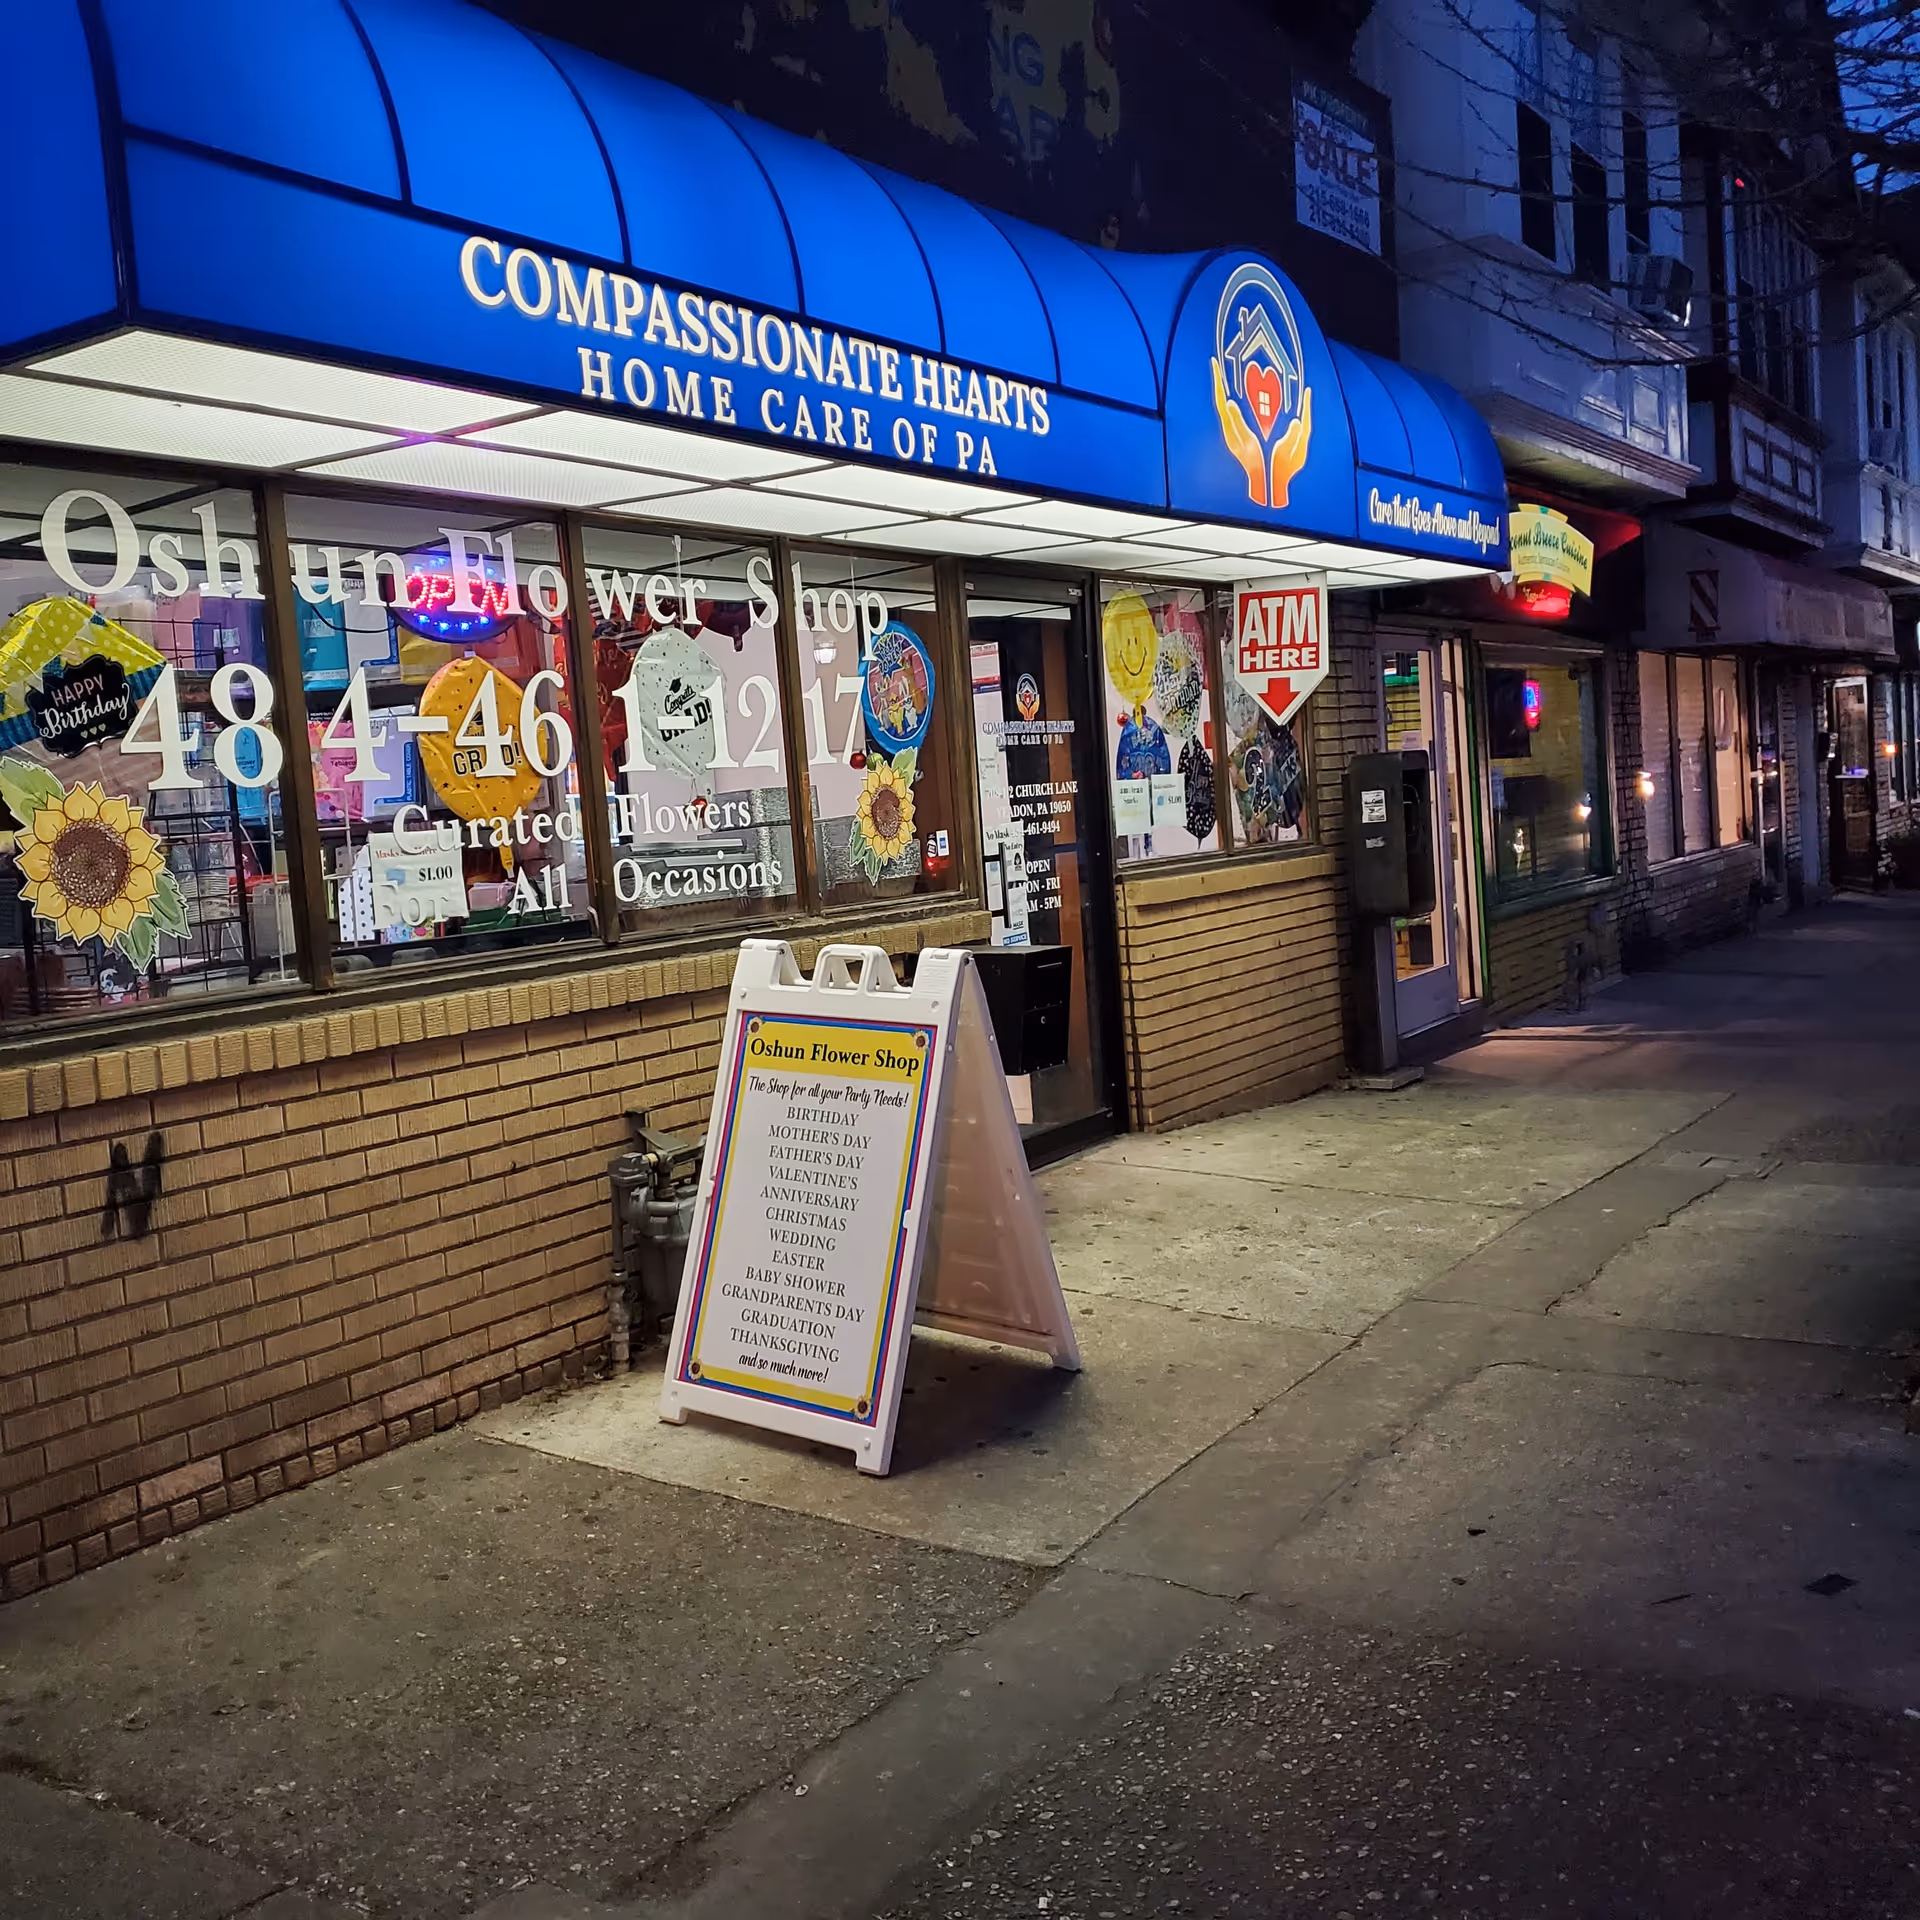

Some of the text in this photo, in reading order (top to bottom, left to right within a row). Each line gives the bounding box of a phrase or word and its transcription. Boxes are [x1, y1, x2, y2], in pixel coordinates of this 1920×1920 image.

[1302, 117, 1378, 198] SALE
[460, 236, 1050, 435] COMPASSIONATE HEARTS
[577, 347, 998, 477] HOME CARE OF PA
[1369, 487, 1500, 554] Care that Goes Above and Beyond
[1533, 521, 1560, 550] Breeze
[1560, 531, 1588, 570] Cuisine
[40, 489, 888, 661] Oshun Flower Shop
[1240, 593, 1318, 648] ATM
[1243, 647, 1317, 670] HERE
[51, 673, 104, 707] HAPPY
[38, 682, 130, 739] Birthday
[121, 662, 865, 791] 484-461-1217
[1020, 735, 1041, 746] CARE
[453, 742, 522, 776] GRD!
[1015, 783, 1054, 798] CHURCH
[1054, 781, 1078, 795] LANE
[393, 794, 752, 853] Curated Flowers
[1037, 803, 1049, 816] PA
[1049, 800, 1072, 815] 19050
[419, 865, 453, 882] $1.00
[1026, 859, 1051, 874] OPEN
[373, 857, 783, 930] For All Occasions
[1045, 877, 1061, 893] FRI
[1026, 899, 1039, 913] AM
[1044, 895, 1062, 910] 5PM
[750, 1036, 920, 1077] Oshun Flower Shop
[749, 1075, 909, 1109] The Shop for all your Party Needs!
[786, 1106, 860, 1127] BIRTHDAY
[768, 1124, 872, 1150] MOTHER'S DAY
[769, 1144, 865, 1170] FATHER'S DAY
[768, 1165, 859, 1190] VALENTINE'S
[759, 1185, 860, 1212] ANNIVERSARY
[765, 1206, 847, 1232] CHRISTMAS
[769, 1228, 836, 1252] WEDDING
[771, 1250, 825, 1272] EASTER
[745, 1266, 846, 1298] BABY SHOWER
[721, 1283, 865, 1323] GRANDPARENTS DAY
[741, 1308, 836, 1340] GRADUATION
[730, 1327, 840, 1364] THANKSGIVING
[738, 1353, 829, 1384] and so much more!
